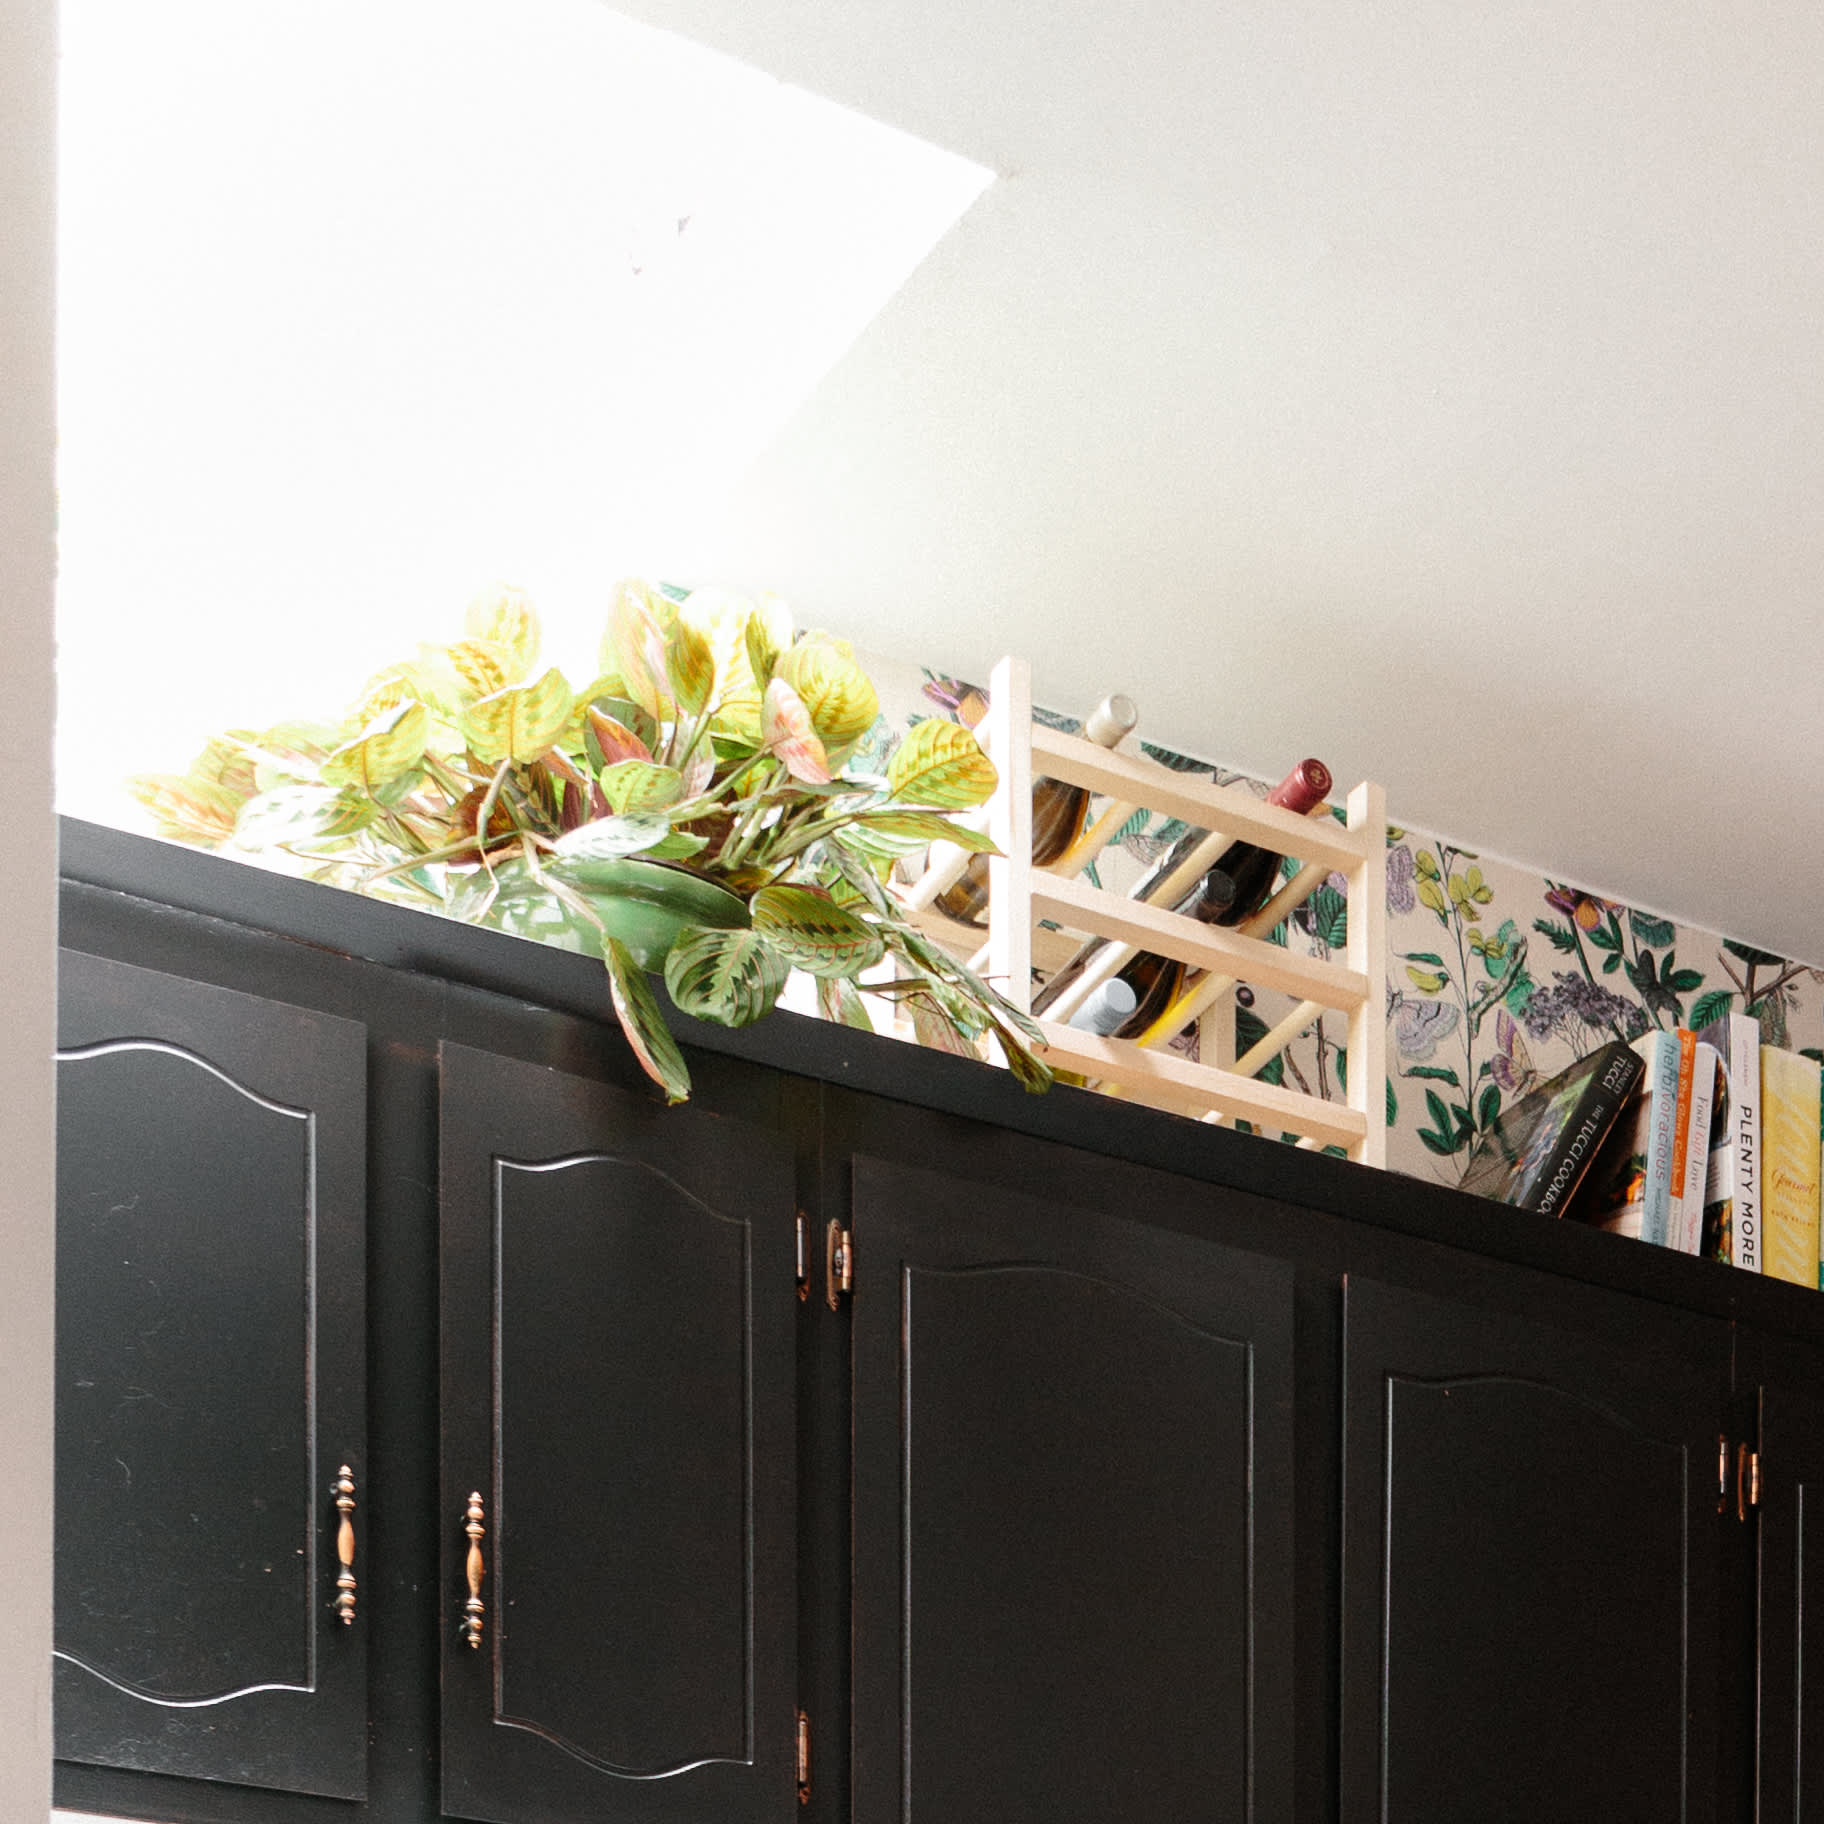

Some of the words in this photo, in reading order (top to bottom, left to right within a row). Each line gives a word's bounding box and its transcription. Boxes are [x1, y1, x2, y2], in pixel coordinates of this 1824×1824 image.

[1602, 1055, 1628, 1090] TUCCI
[1655, 1042, 1677, 1181] herbivoracious
[1694, 1096, 1709, 1130] Food
[1569, 1119, 1597, 1161] TUCCI
[1740, 1105, 1753, 1193] PLENTY
[1691, 1160, 1704, 1191] Love
[1741, 1202, 1754, 1267] MORE
